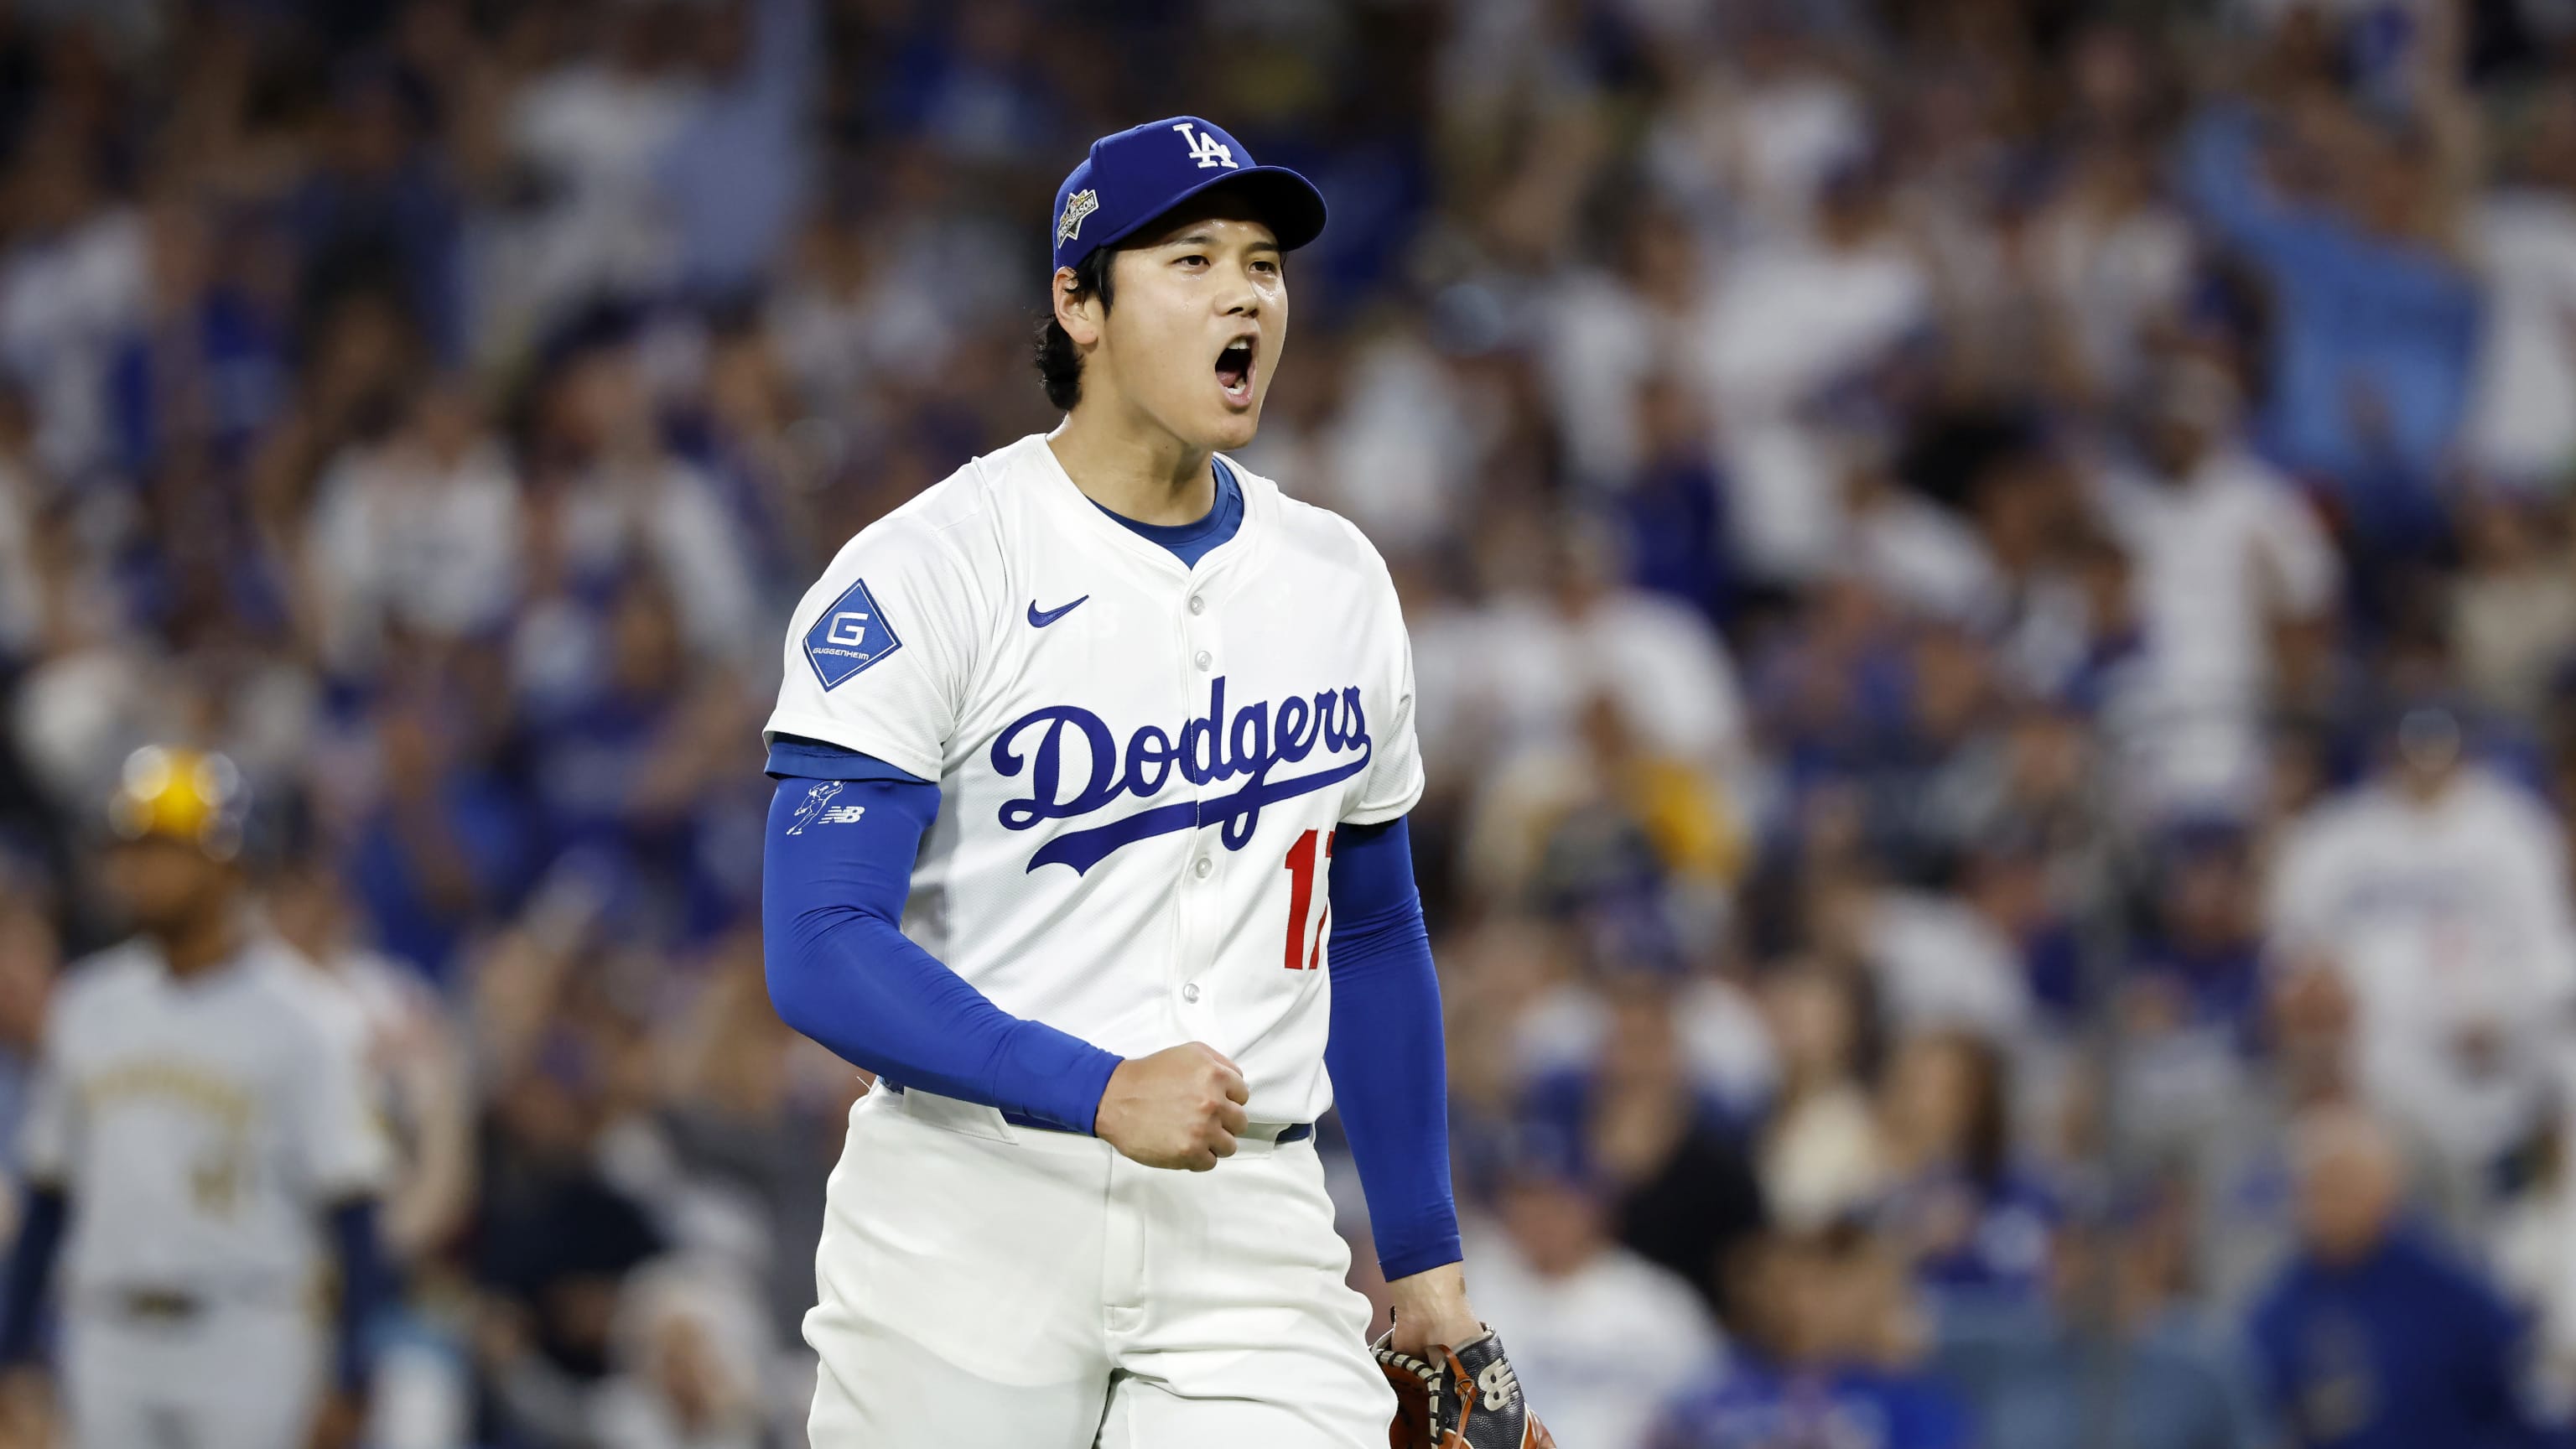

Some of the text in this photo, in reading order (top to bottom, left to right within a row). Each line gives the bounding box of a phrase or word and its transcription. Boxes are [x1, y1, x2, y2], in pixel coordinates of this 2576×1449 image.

[1173, 123, 1239, 169] LA
[827, 612, 869, 646] G
[813, 647, 870, 661] GUGGENHEIM
[990, 676, 1371, 852] Dodgers
